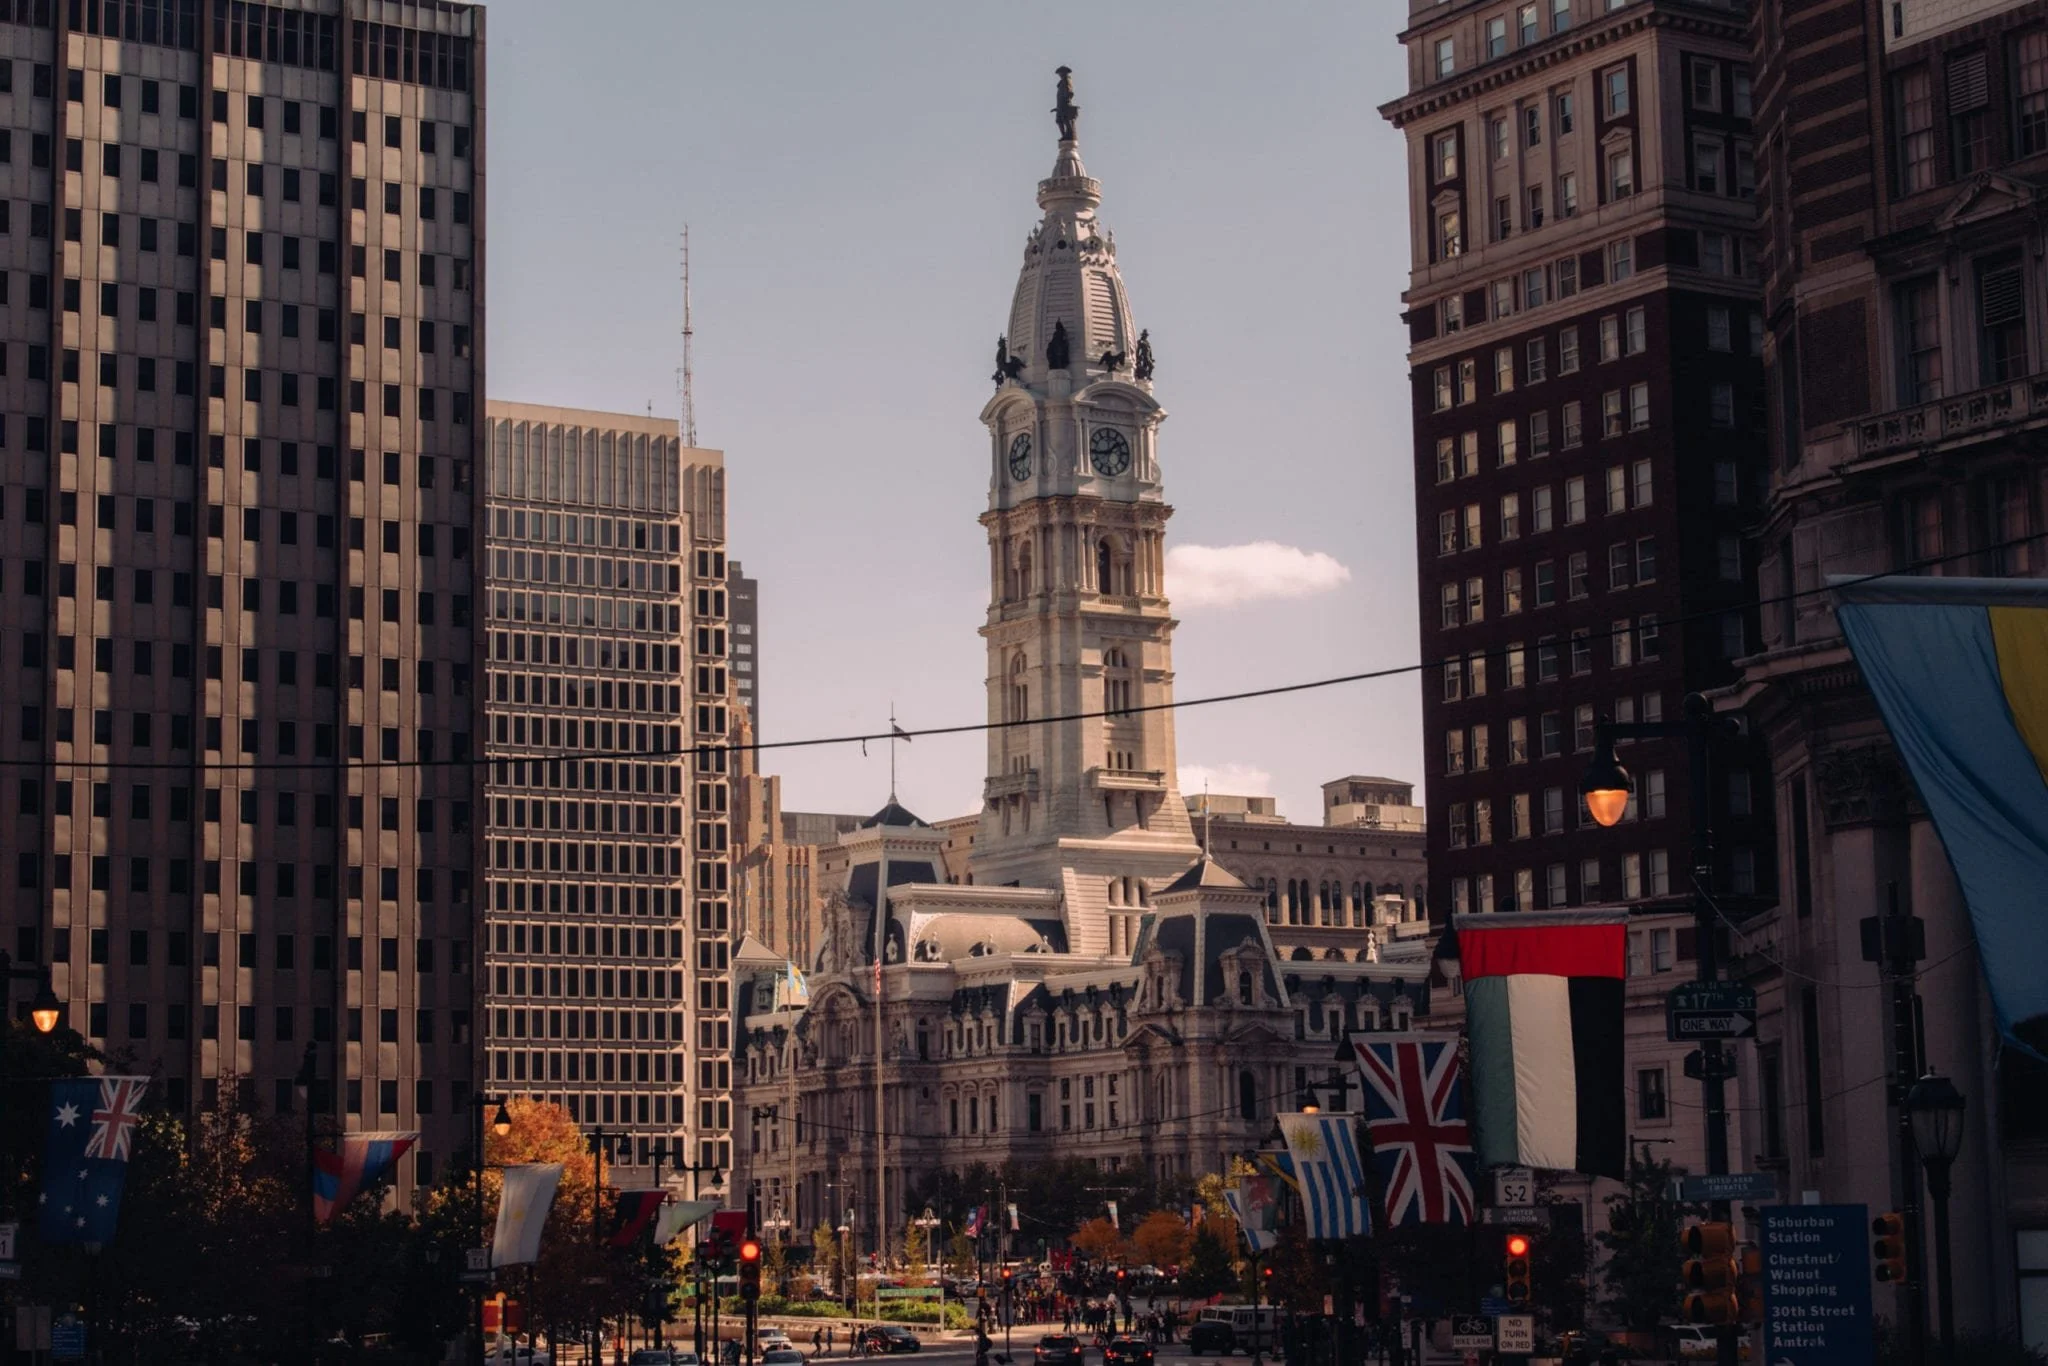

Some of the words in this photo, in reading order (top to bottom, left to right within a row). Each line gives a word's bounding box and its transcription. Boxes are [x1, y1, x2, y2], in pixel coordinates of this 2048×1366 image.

[1691, 992, 1724, 1009] 17TH
[1736, 996, 1753, 1008] ST
[1683, 1019, 1706, 1031] ONE
[1708, 1019, 1732, 1031] WAY
[1504, 1184, 1527, 1202] S-2
[1768, 1217, 1834, 1228] Suburban
[1768, 1232, 1821, 1244] Station
[1769, 1253, 1842, 1266] Chestnut/
[1770, 1269, 1821, 1281] Walnut
[1771, 1284, 1837, 1297] Shopping
[1771, 1306, 1806, 1317] 30th
[1810, 1304, 1856, 1317] Street
[1772, 1321, 1824, 1333] Station
[1504, 1330, 1528, 1338] TURN
[1773, 1336, 1826, 1348] Amtrak
